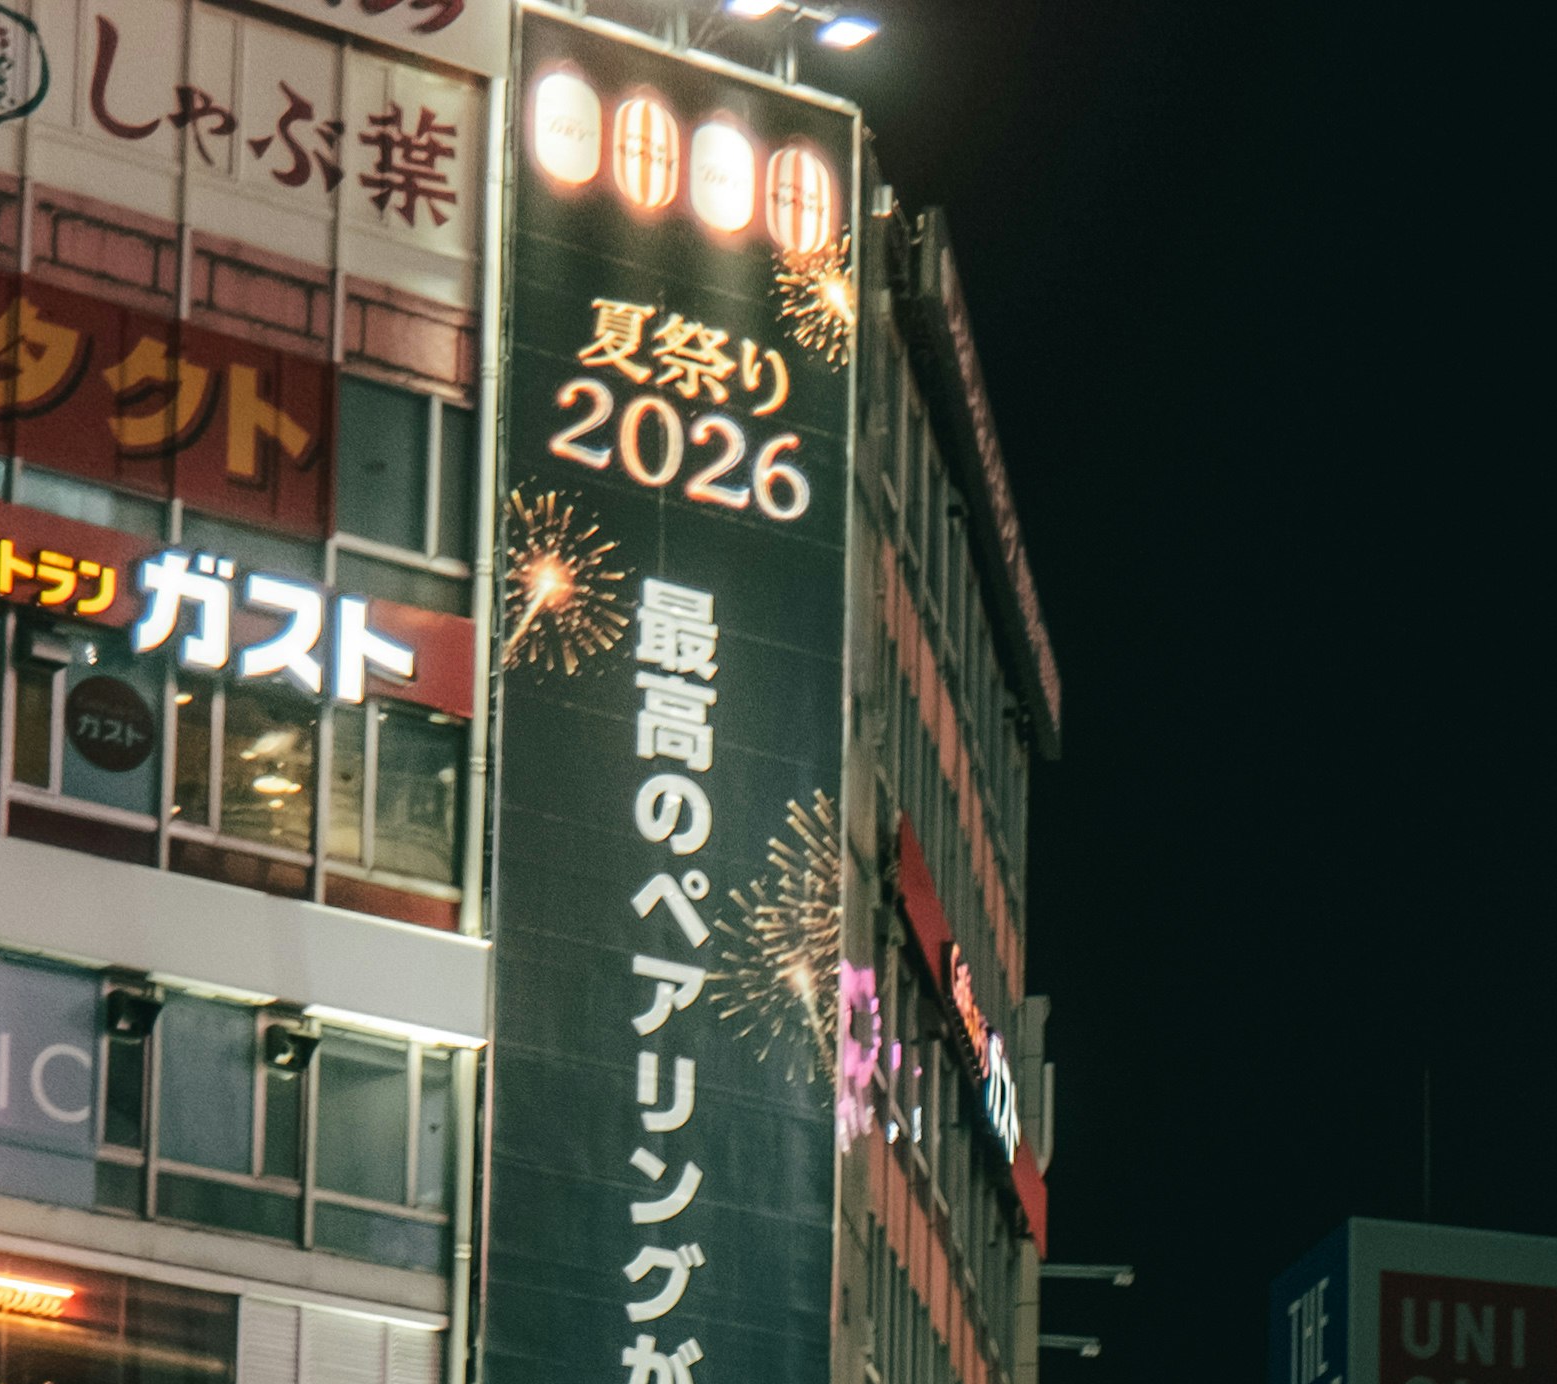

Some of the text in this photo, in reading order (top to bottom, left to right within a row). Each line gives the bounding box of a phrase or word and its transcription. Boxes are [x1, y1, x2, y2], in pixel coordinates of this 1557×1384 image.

[87, 13, 458, 228] しゃぶ葉
[577, 299, 793, 417] 夏祭り
[551, 378, 810, 521] 2026
[132, 550, 415, 703] ガスト
[78, 713, 147, 748] ガスト
[1401, 1297, 1527, 1369] UNI
